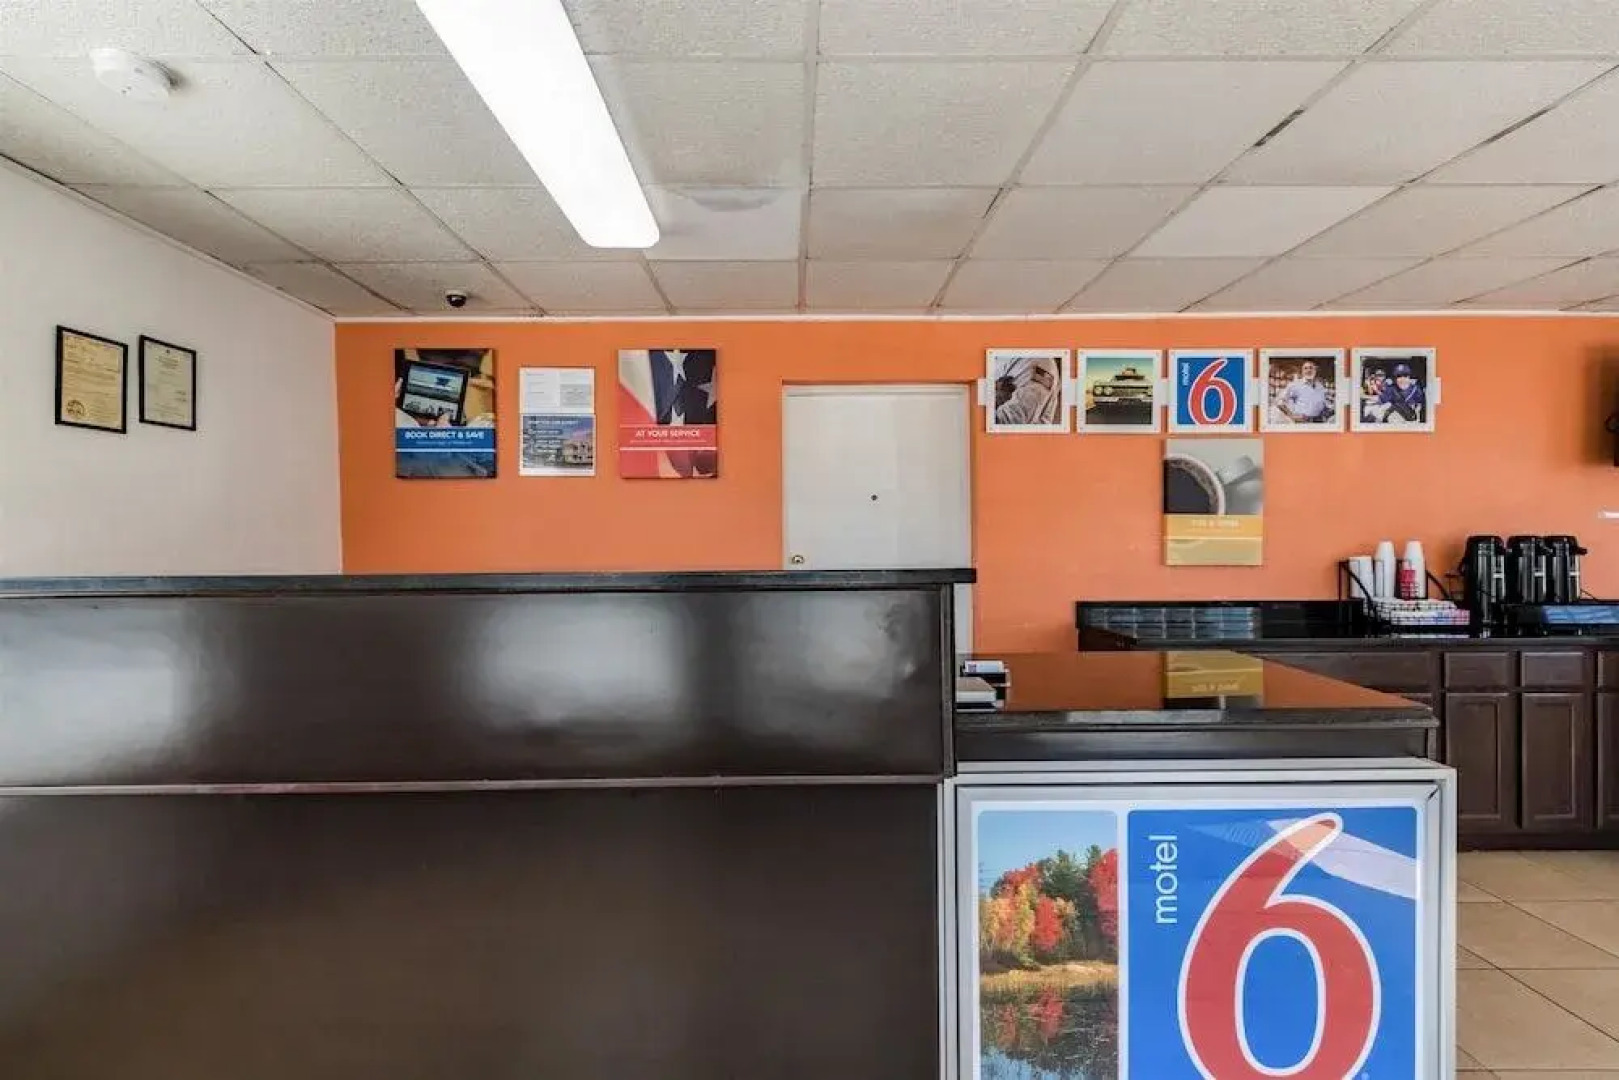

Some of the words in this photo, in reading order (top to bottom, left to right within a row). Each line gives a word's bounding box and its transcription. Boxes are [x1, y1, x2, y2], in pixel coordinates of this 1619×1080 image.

[1181, 362, 1191, 386] motel
[1188, 358, 1237, 425] 6
[404, 431, 428, 440] BOOK
[429, 431, 456, 439] DIRECT
[457, 431, 464, 439] &
[466, 431, 485, 439] SAVE
[635, 429, 645, 439] AT
[648, 429, 668, 439] YOUR
[669, 429, 700, 438] SERVICE
[1148, 834, 1178, 924] motel
[1177, 812, 1382, 1080] 6
